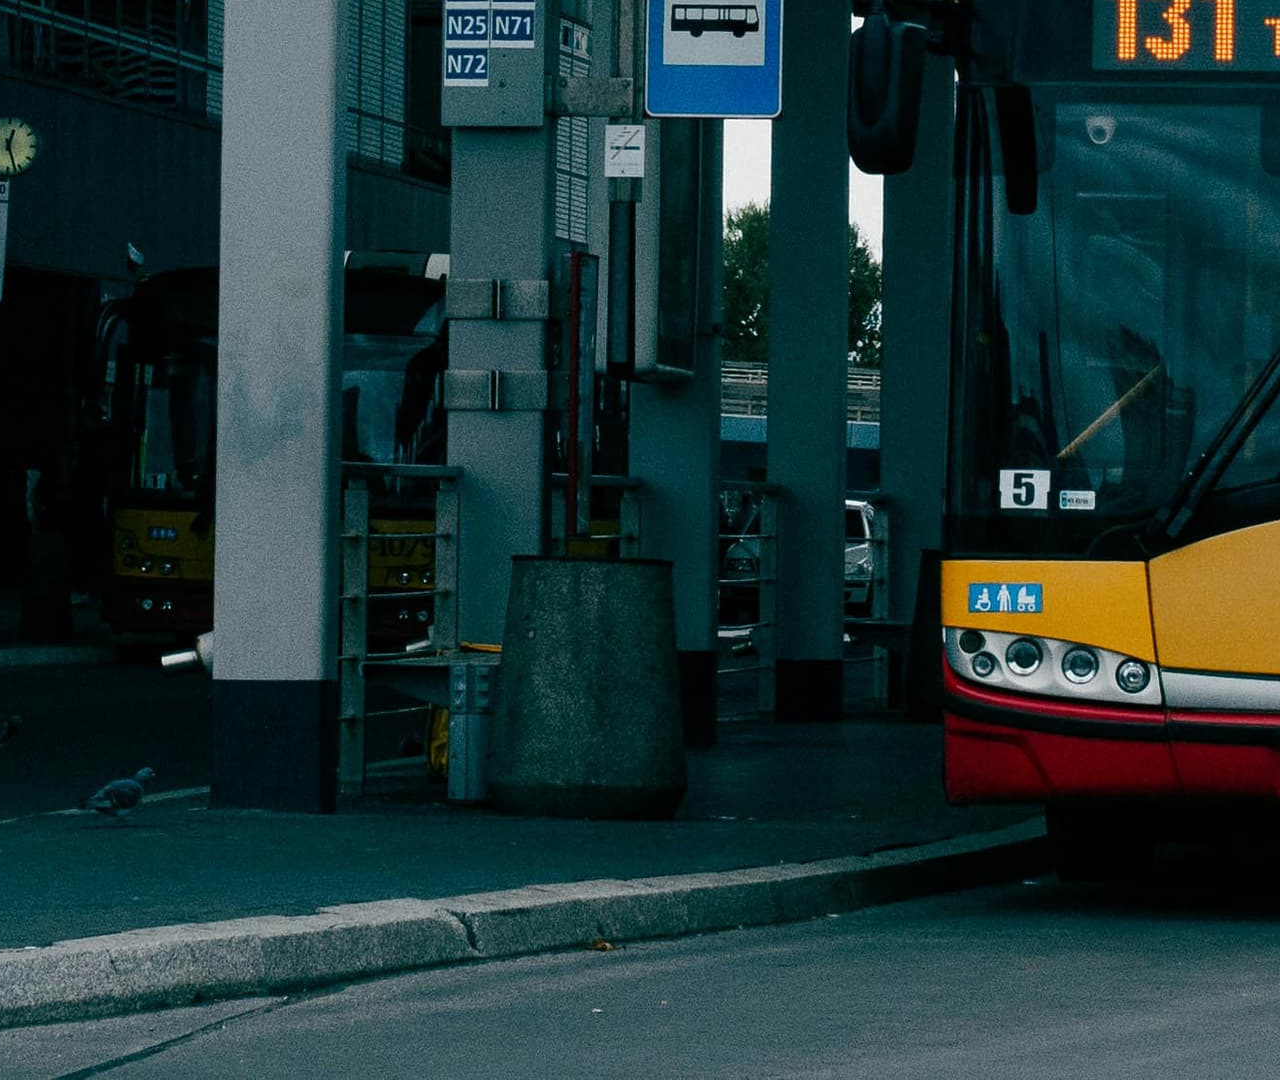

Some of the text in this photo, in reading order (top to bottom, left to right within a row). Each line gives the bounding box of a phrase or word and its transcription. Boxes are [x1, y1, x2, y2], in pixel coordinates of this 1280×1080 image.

[447, 15, 532, 36] N25 N71
[447, 54, 486, 74] N72
[1013, 473, 1035, 506] 5
